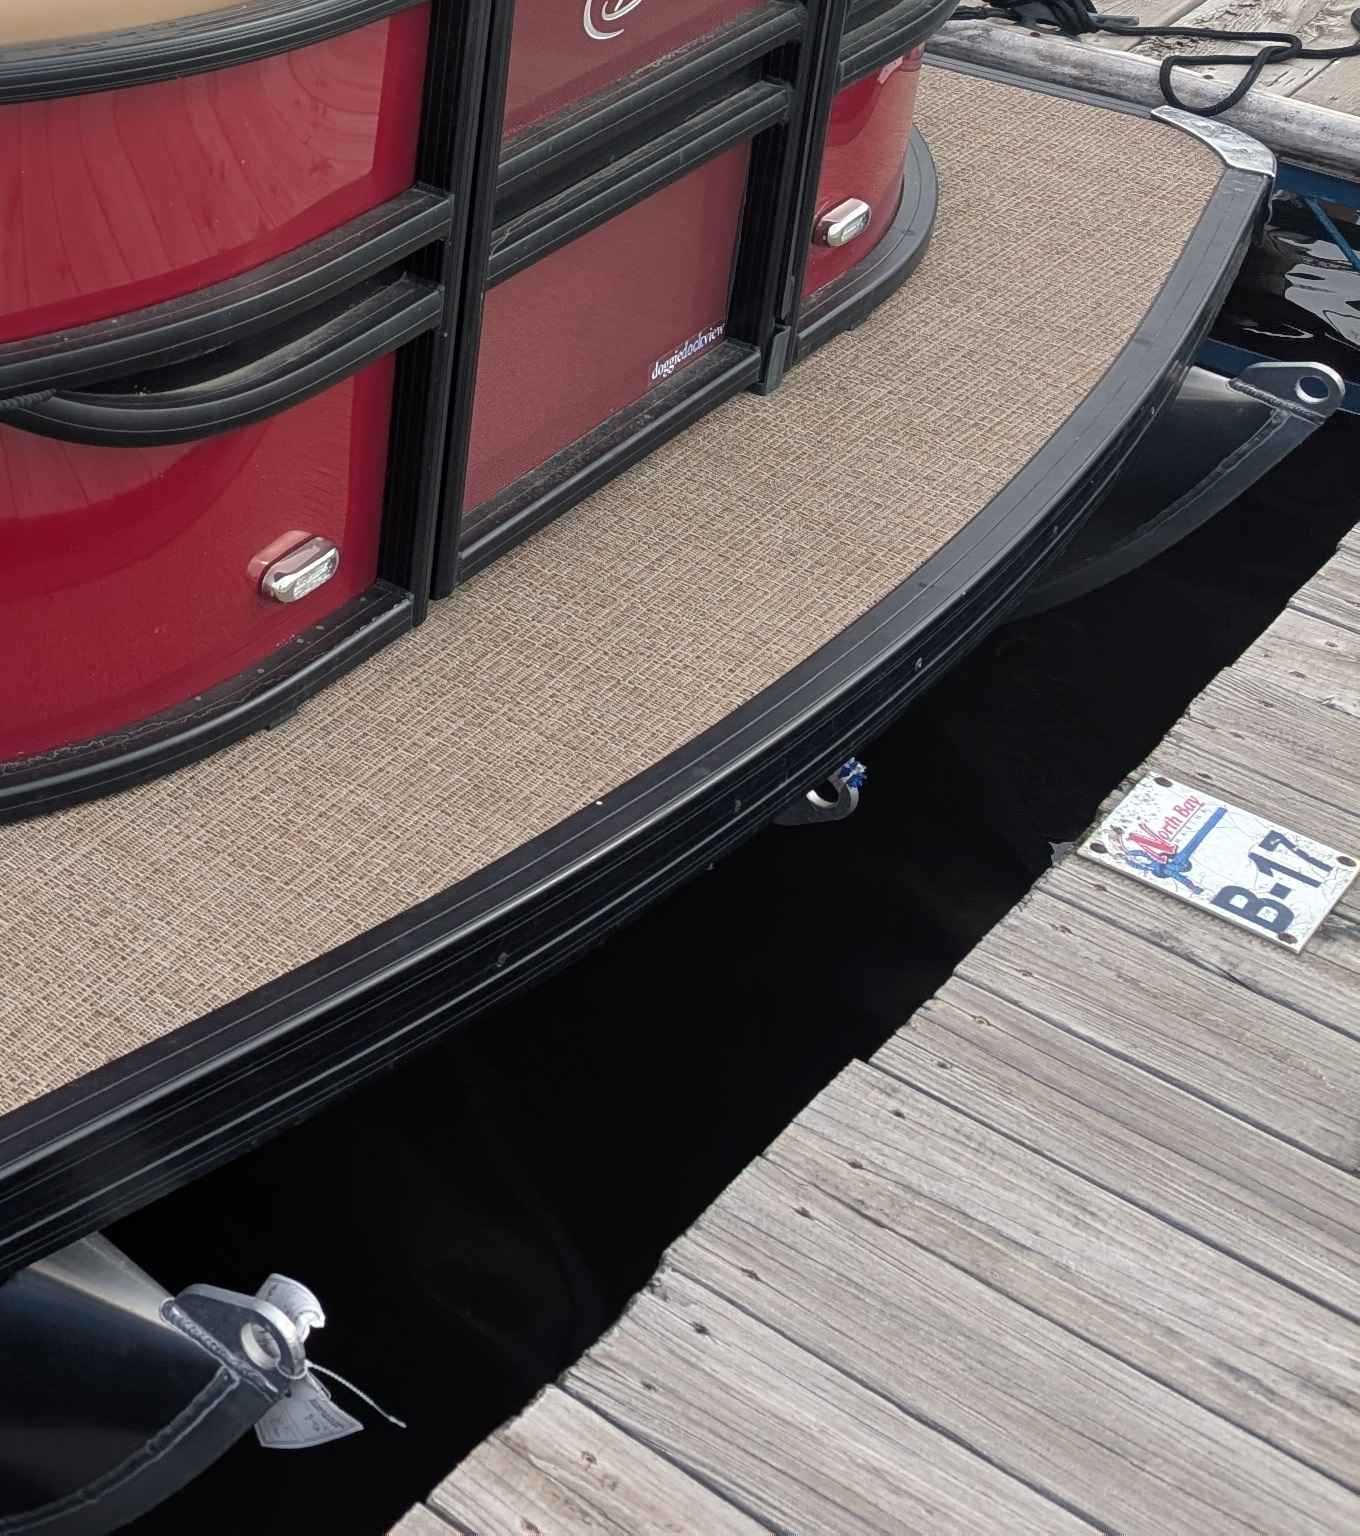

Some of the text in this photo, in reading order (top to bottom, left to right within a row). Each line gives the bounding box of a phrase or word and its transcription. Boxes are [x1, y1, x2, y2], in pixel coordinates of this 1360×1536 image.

[1126, 794, 1205, 864] North Bay
[1210, 830, 1334, 935] B-17
